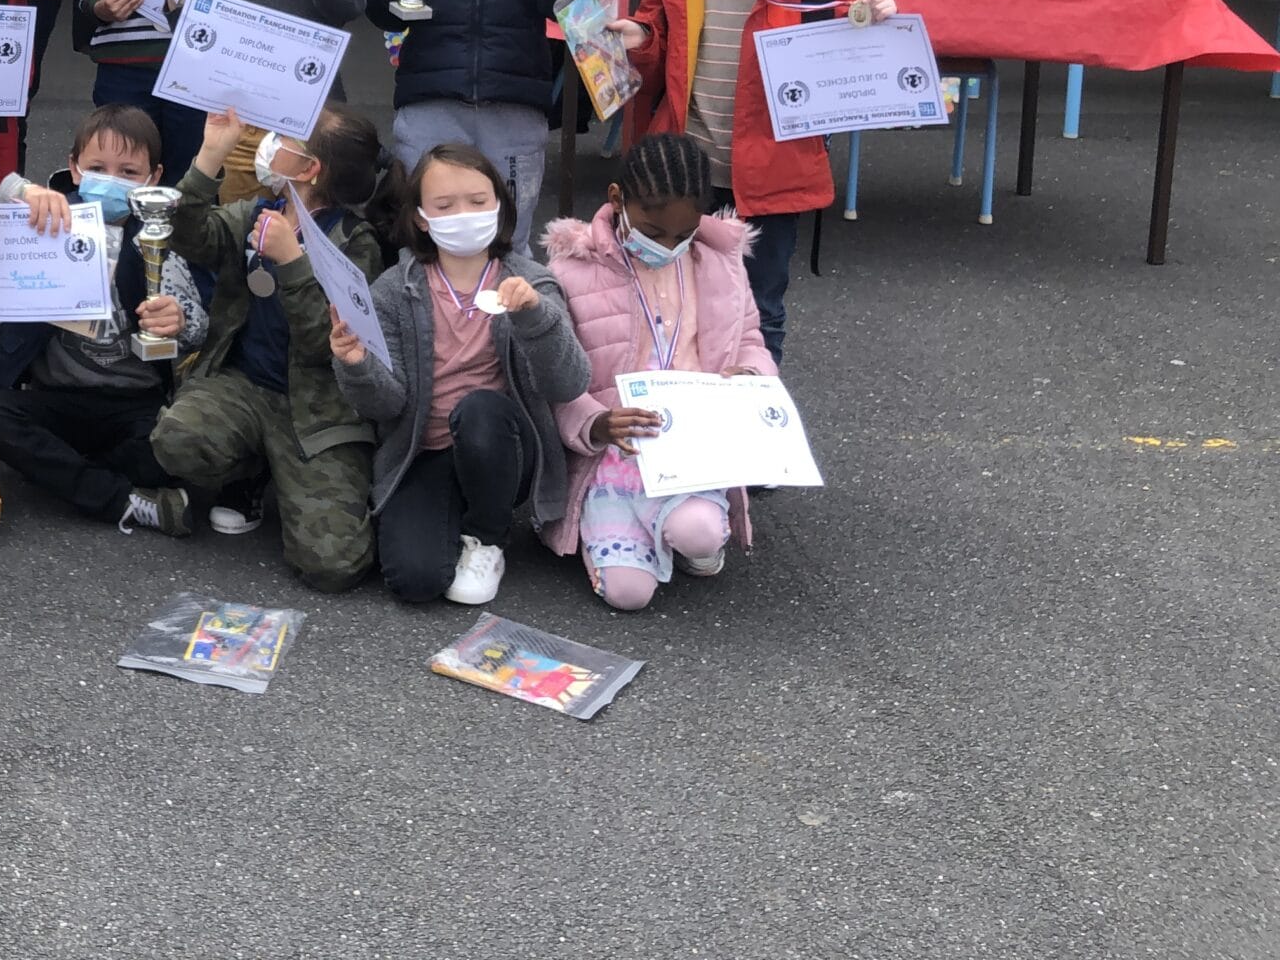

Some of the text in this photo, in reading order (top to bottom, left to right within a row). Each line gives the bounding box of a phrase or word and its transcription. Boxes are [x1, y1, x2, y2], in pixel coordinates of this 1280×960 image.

[0, 11, 28, 23] ÉCHECS
[214, 2, 339, 47] FÉDÉRATION FRANÇAISE DES ÉCHECS
[239, 36, 275, 54] DIPLÔME
[220, 47, 288, 74] DU JEU D'ÉCHECS
[816, 72, 888, 89] DU JEU D'ÉCHECS
[838, 89, 877, 101] DIPLÔME
[782, 108, 917, 131] FÉDÉRATION FRANÇAISE DES ÉCHECS
[4, 236, 39, 246] DIPLÔME
[5, 252, 19, 261] JEU
[20, 250, 58, 261] D'ÉCHECS
